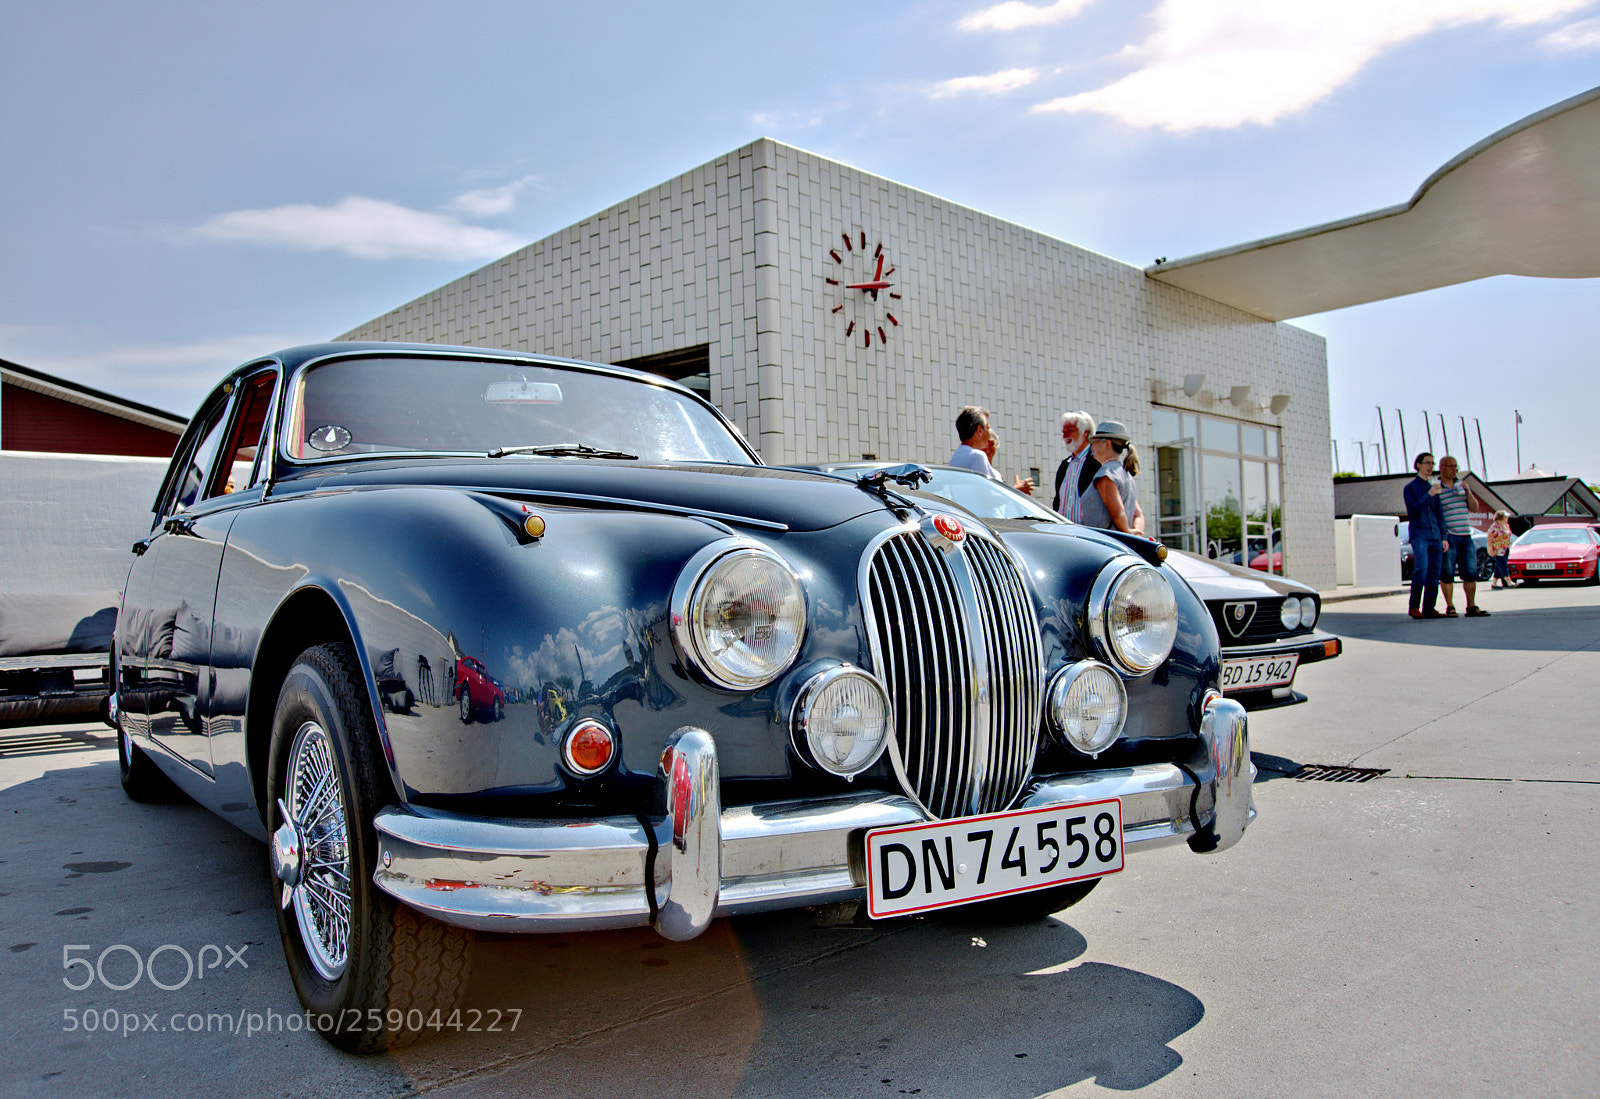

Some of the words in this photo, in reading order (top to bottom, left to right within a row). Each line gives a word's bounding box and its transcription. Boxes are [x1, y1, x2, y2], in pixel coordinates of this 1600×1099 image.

[1223, 666, 1243, 685] BD
[1245, 663, 1264, 683] 15
[1266, 661, 1291, 681] 942
[880, 836, 955, 900] DN
